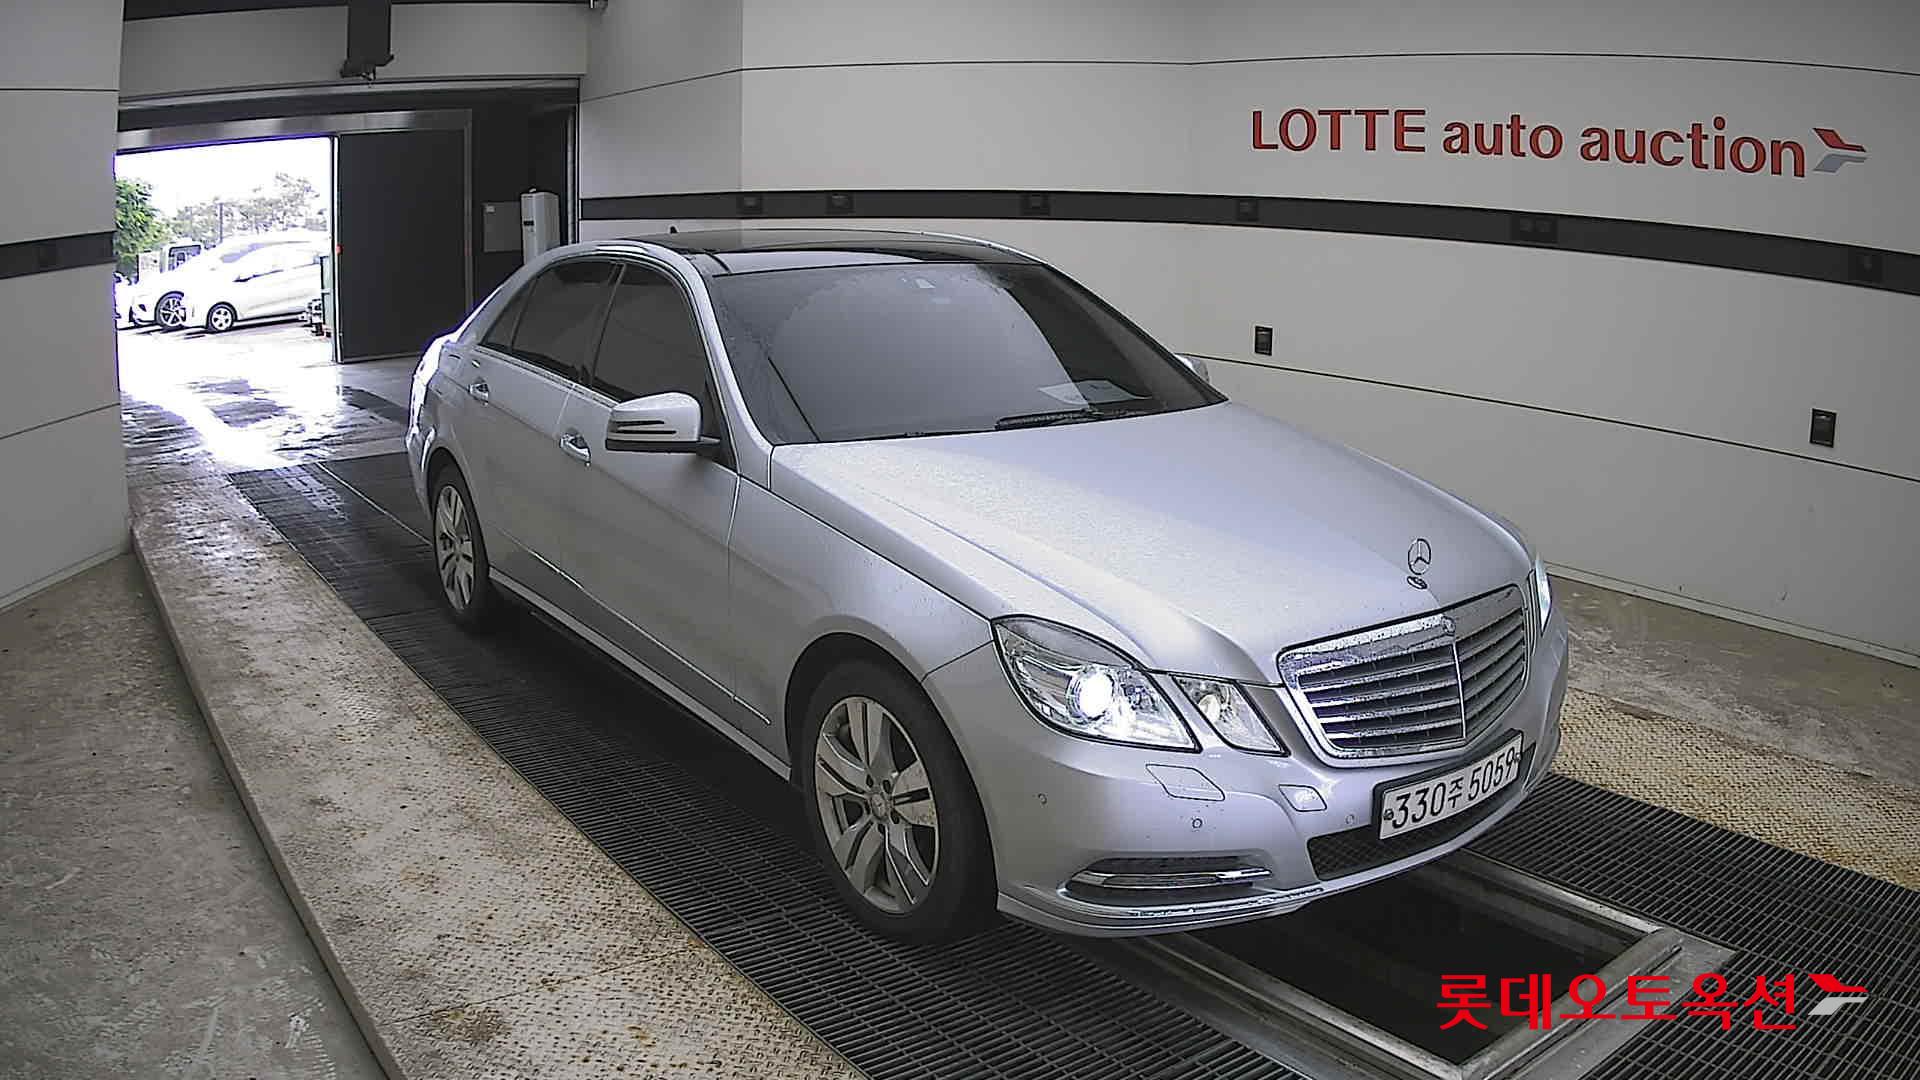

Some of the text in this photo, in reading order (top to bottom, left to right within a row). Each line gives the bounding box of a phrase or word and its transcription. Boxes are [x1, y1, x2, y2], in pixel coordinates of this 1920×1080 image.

[1252, 109, 1806, 178] LOTTE auto auction
[1392, 746, 1516, 829] 330주 5059
